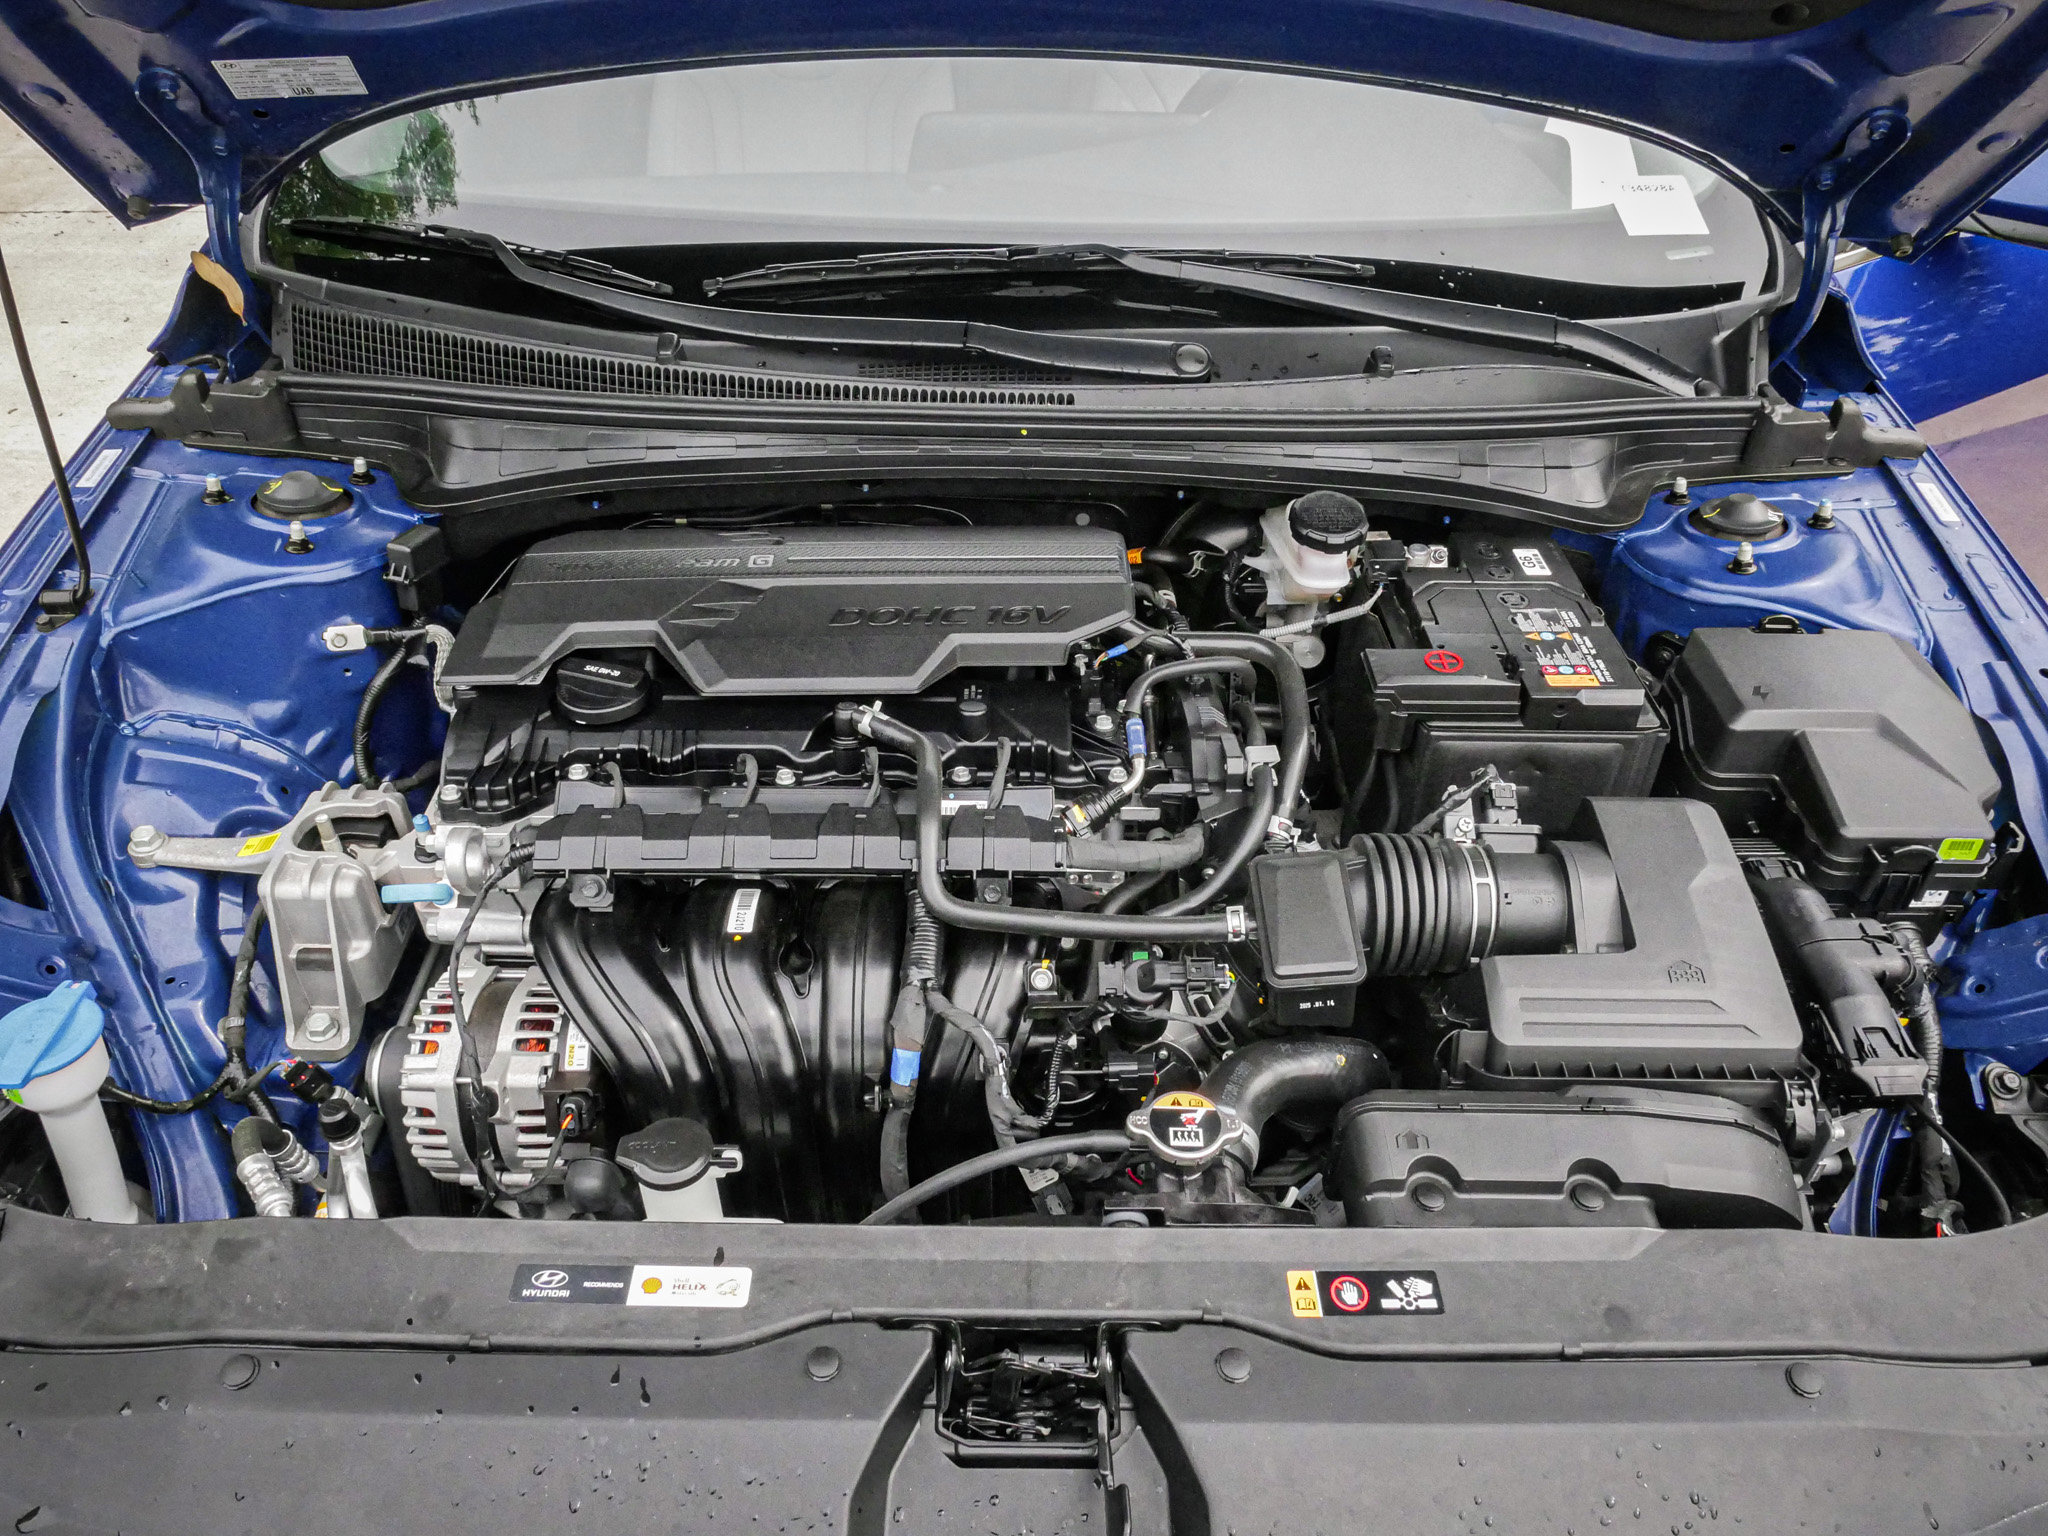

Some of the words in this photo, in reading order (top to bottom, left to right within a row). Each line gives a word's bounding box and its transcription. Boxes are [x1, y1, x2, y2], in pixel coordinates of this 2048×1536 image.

[291, 87, 315, 96] UAB
[1519, 556, 1536, 568] G6
[829, 605, 976, 627] DOHC
[987, 605, 1071, 626] 16V
[584, 664, 600, 673] SAE
[672, 1282, 706, 1291] HELIX
[522, 1288, 570, 1298] HYUNDAI
